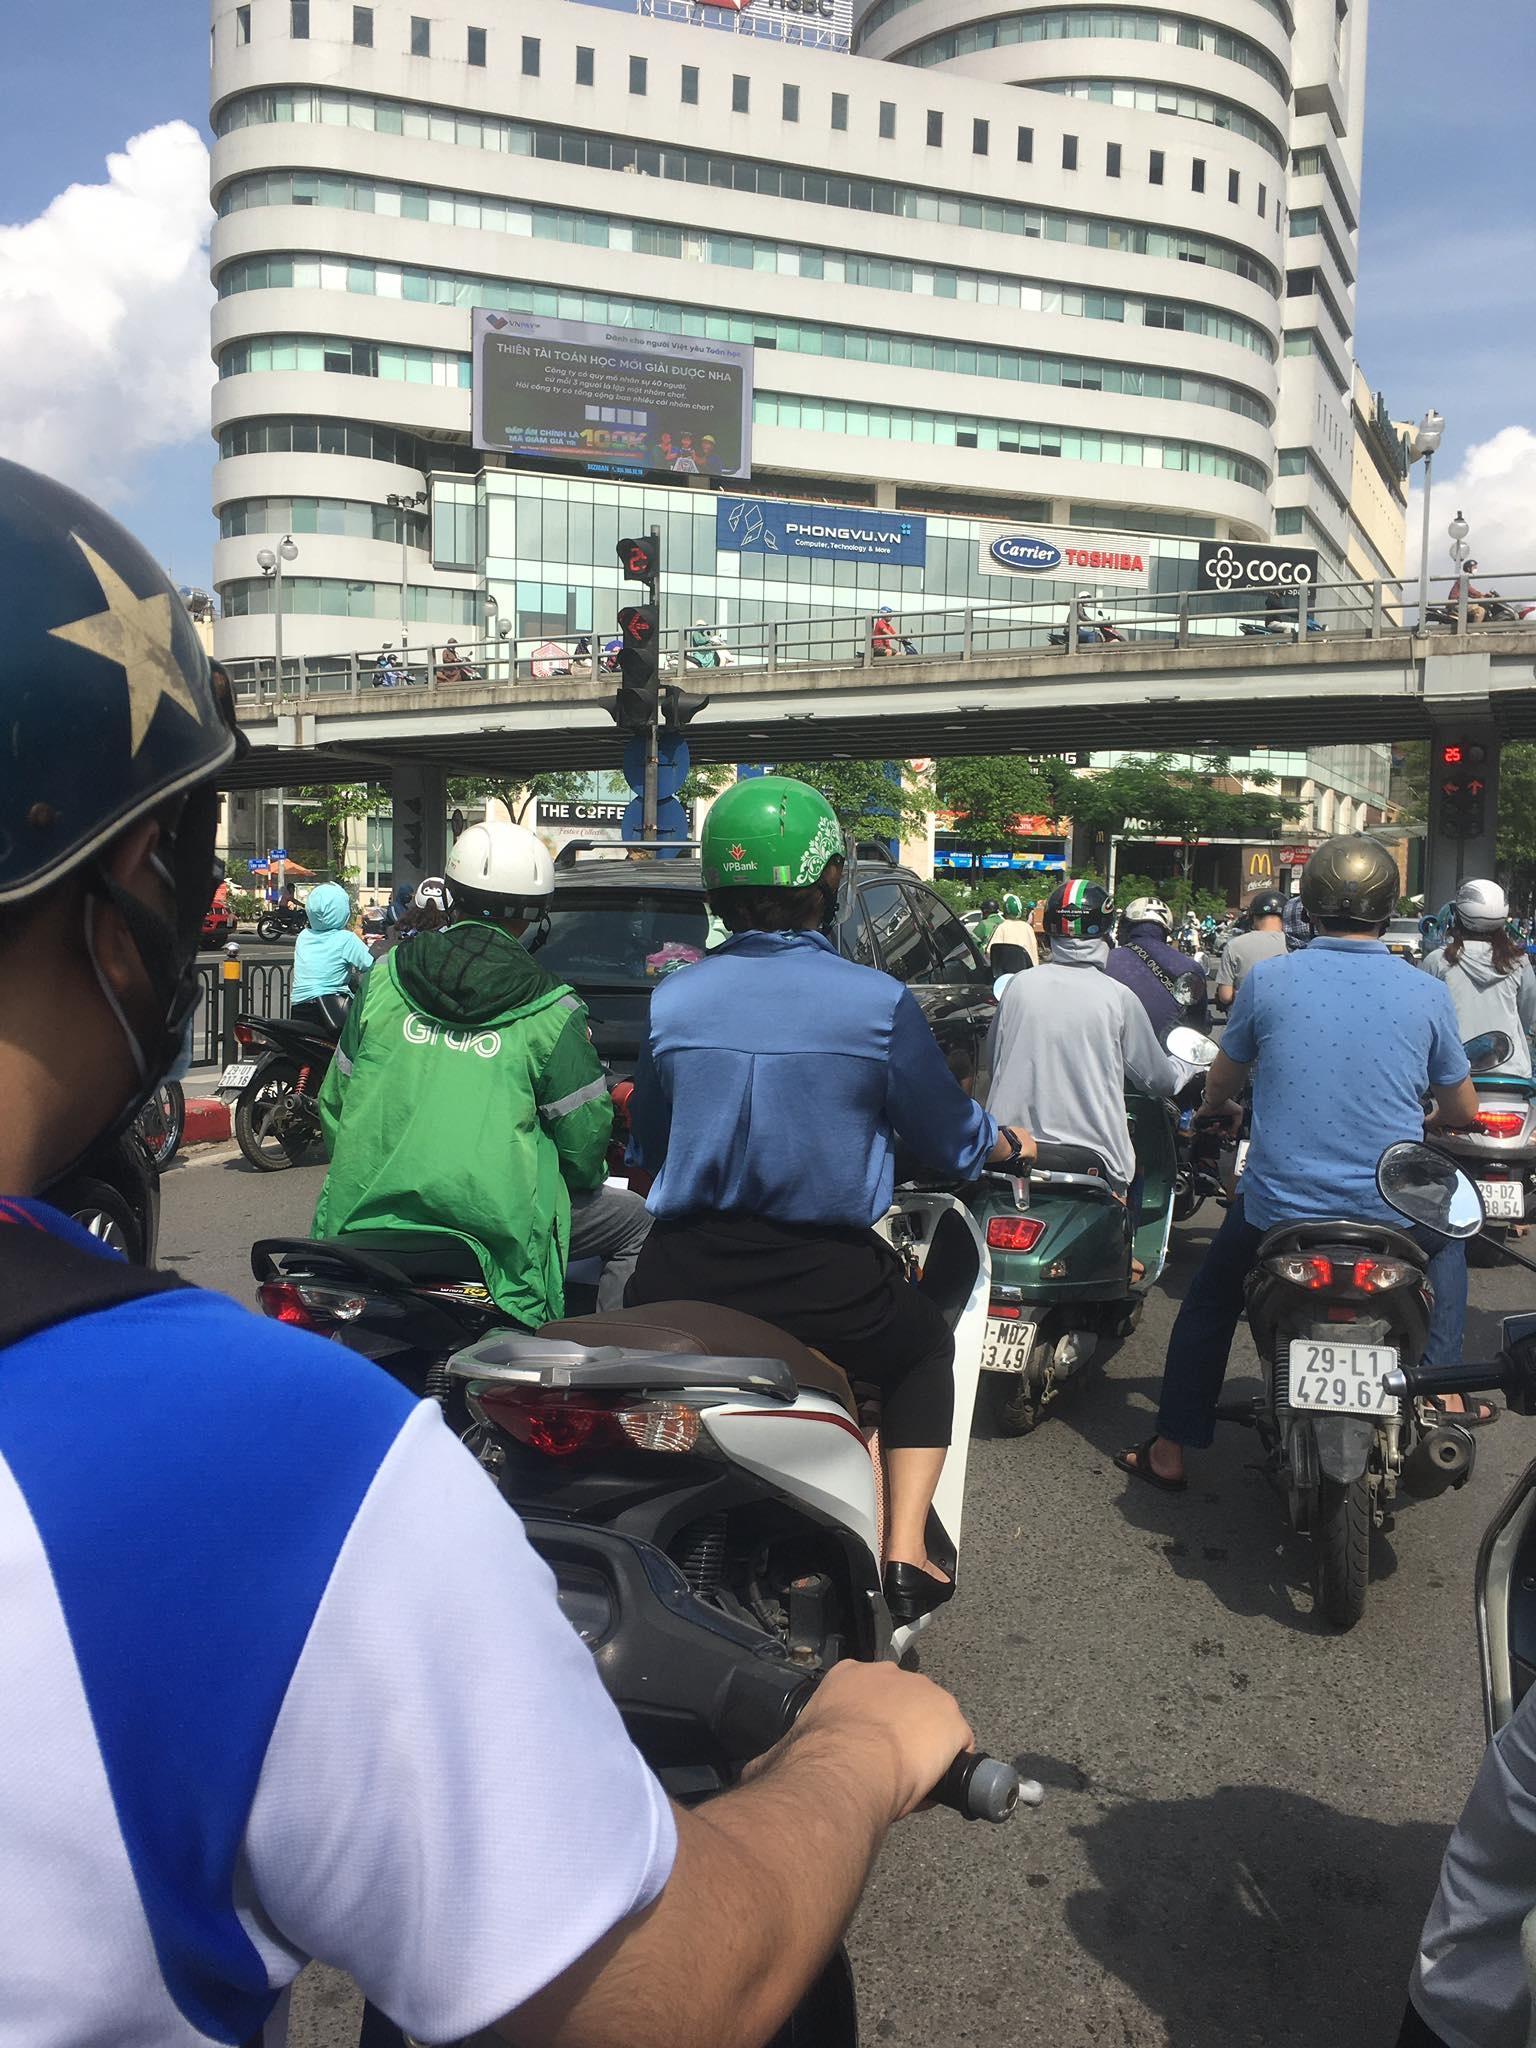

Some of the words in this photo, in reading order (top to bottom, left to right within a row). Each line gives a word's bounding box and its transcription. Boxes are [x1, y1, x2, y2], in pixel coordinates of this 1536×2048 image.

[496, 342, 530, 356] THIÊN
[534, 346, 551, 359] TÀI
[554, 349, 587, 363] TOÁN
[590, 356, 616, 368] HỌC
[620, 358, 641, 370] MỚI
[645, 361, 668, 374] GIẢI
[672, 366, 705, 379] ĐƯỢC
[708, 371, 731, 382] NHA
[545, 366, 566, 376] Công
[568, 369, 577, 377] ty
[589, 372, 604, 381] quy
[652, 379, 662, 387] 40
[786, 523, 901, 544] PHONGVU.VN
[830, 542, 867, 552] Technology
[999, 540, 1055, 561] Carrier
[1065, 549, 1144, 572] TOSHIBA
[1246, 560, 1312, 584] COGO
[1445, 747, 1460, 762] 25
[541, 804, 569, 818] THE
[575, 805, 626, 820] COFFE
[723, 860, 758, 872] VPBank
[1480, 1184, 1515, 1200] 29-D2
[1306, 1346, 1378, 1378] 29-L1
[1297, 1376, 1386, 1409] 429.67
